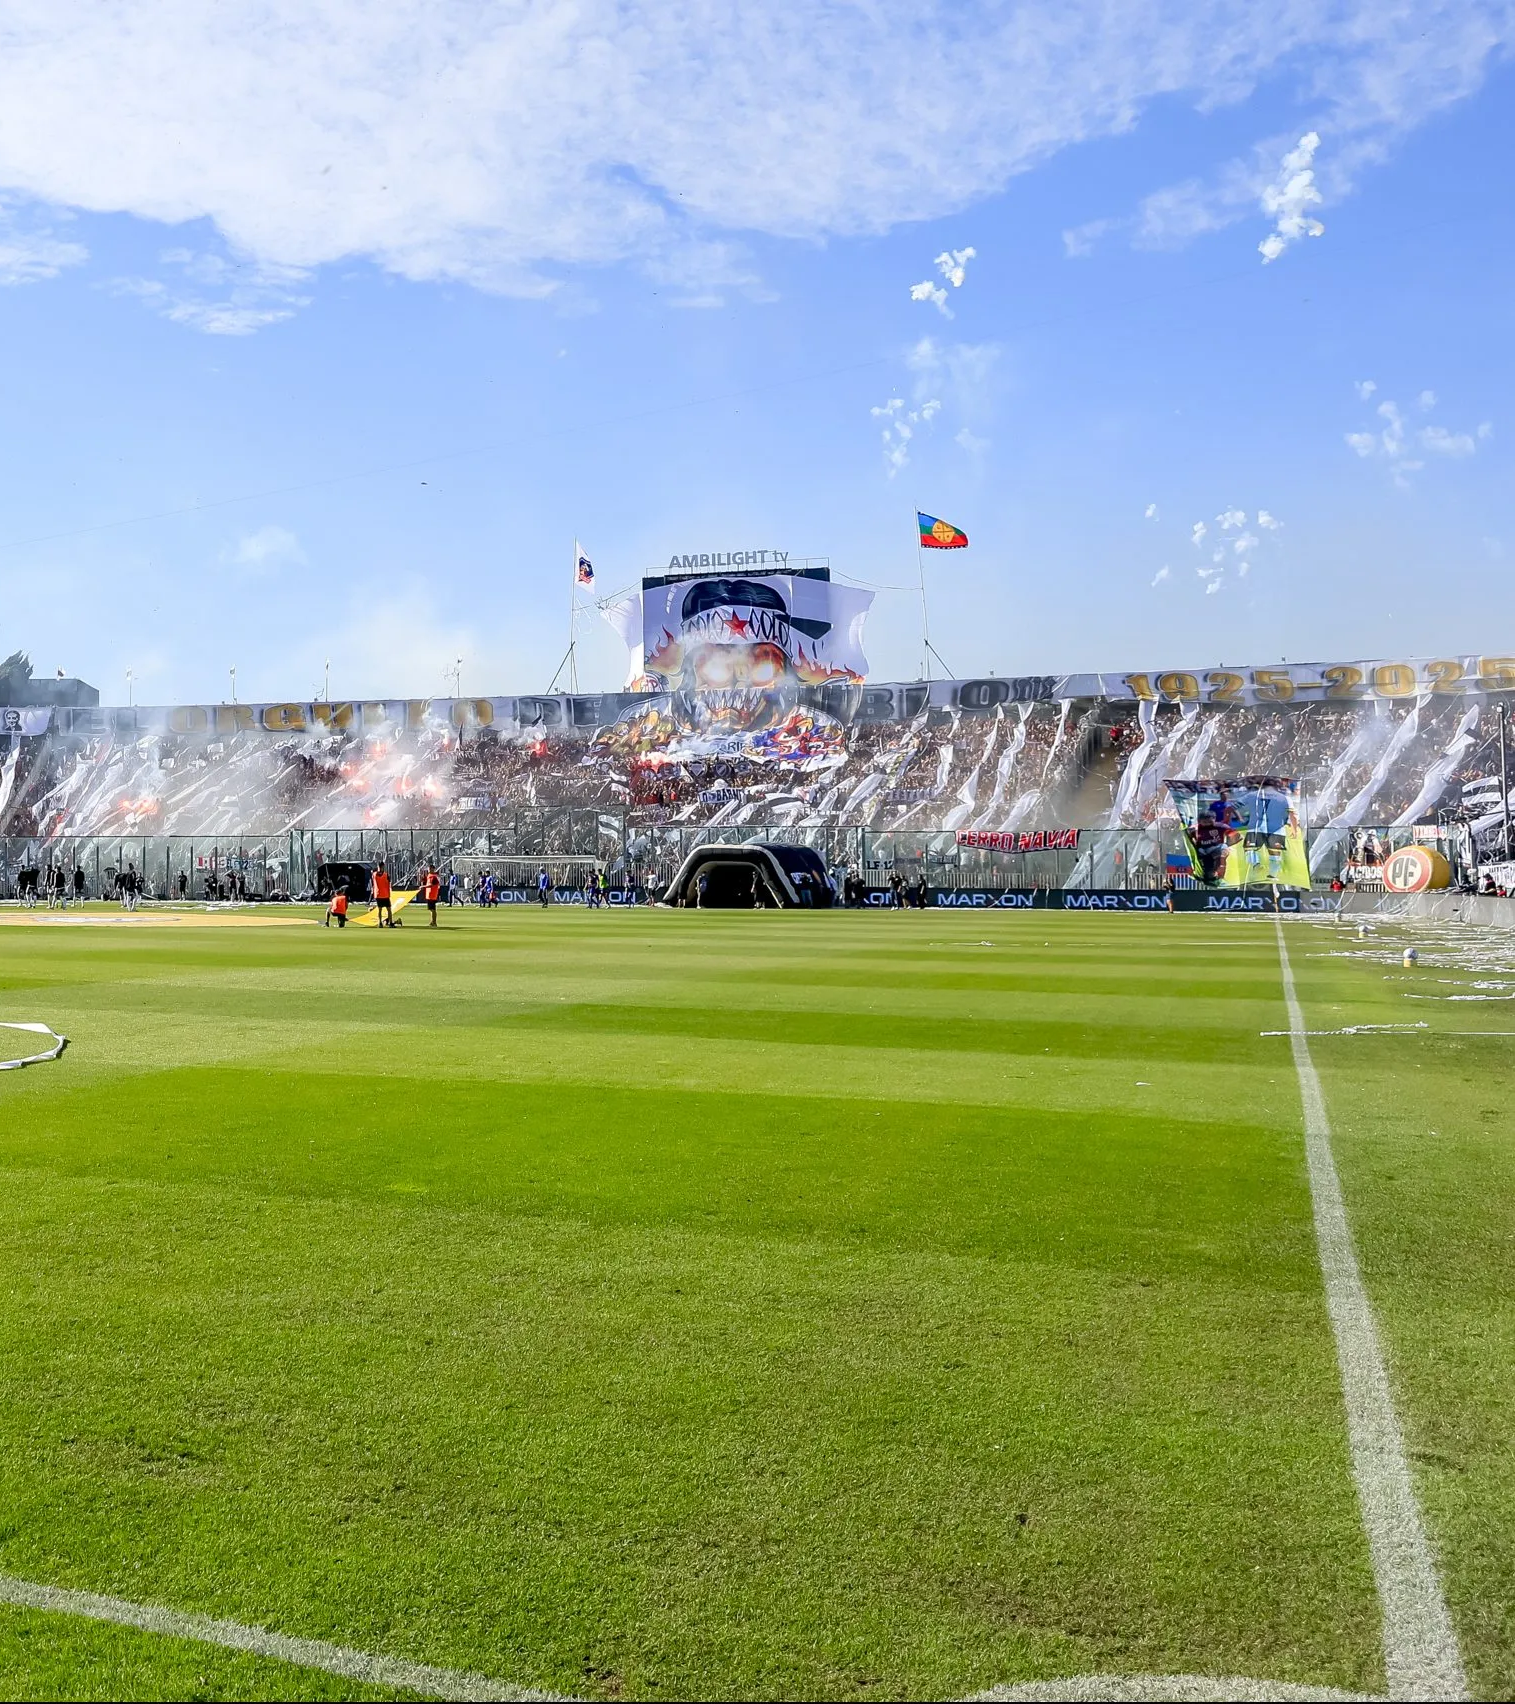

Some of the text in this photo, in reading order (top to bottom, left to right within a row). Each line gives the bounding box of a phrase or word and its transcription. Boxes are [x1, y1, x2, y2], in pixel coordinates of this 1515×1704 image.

[669, 550, 789, 568] AMBILIGHT tv
[956, 830, 1014, 850] CERRO
[1392, 856, 1418, 887] PF
[938, 893, 1033, 908] MARXON
[1066, 894, 1167, 909] MARXON
